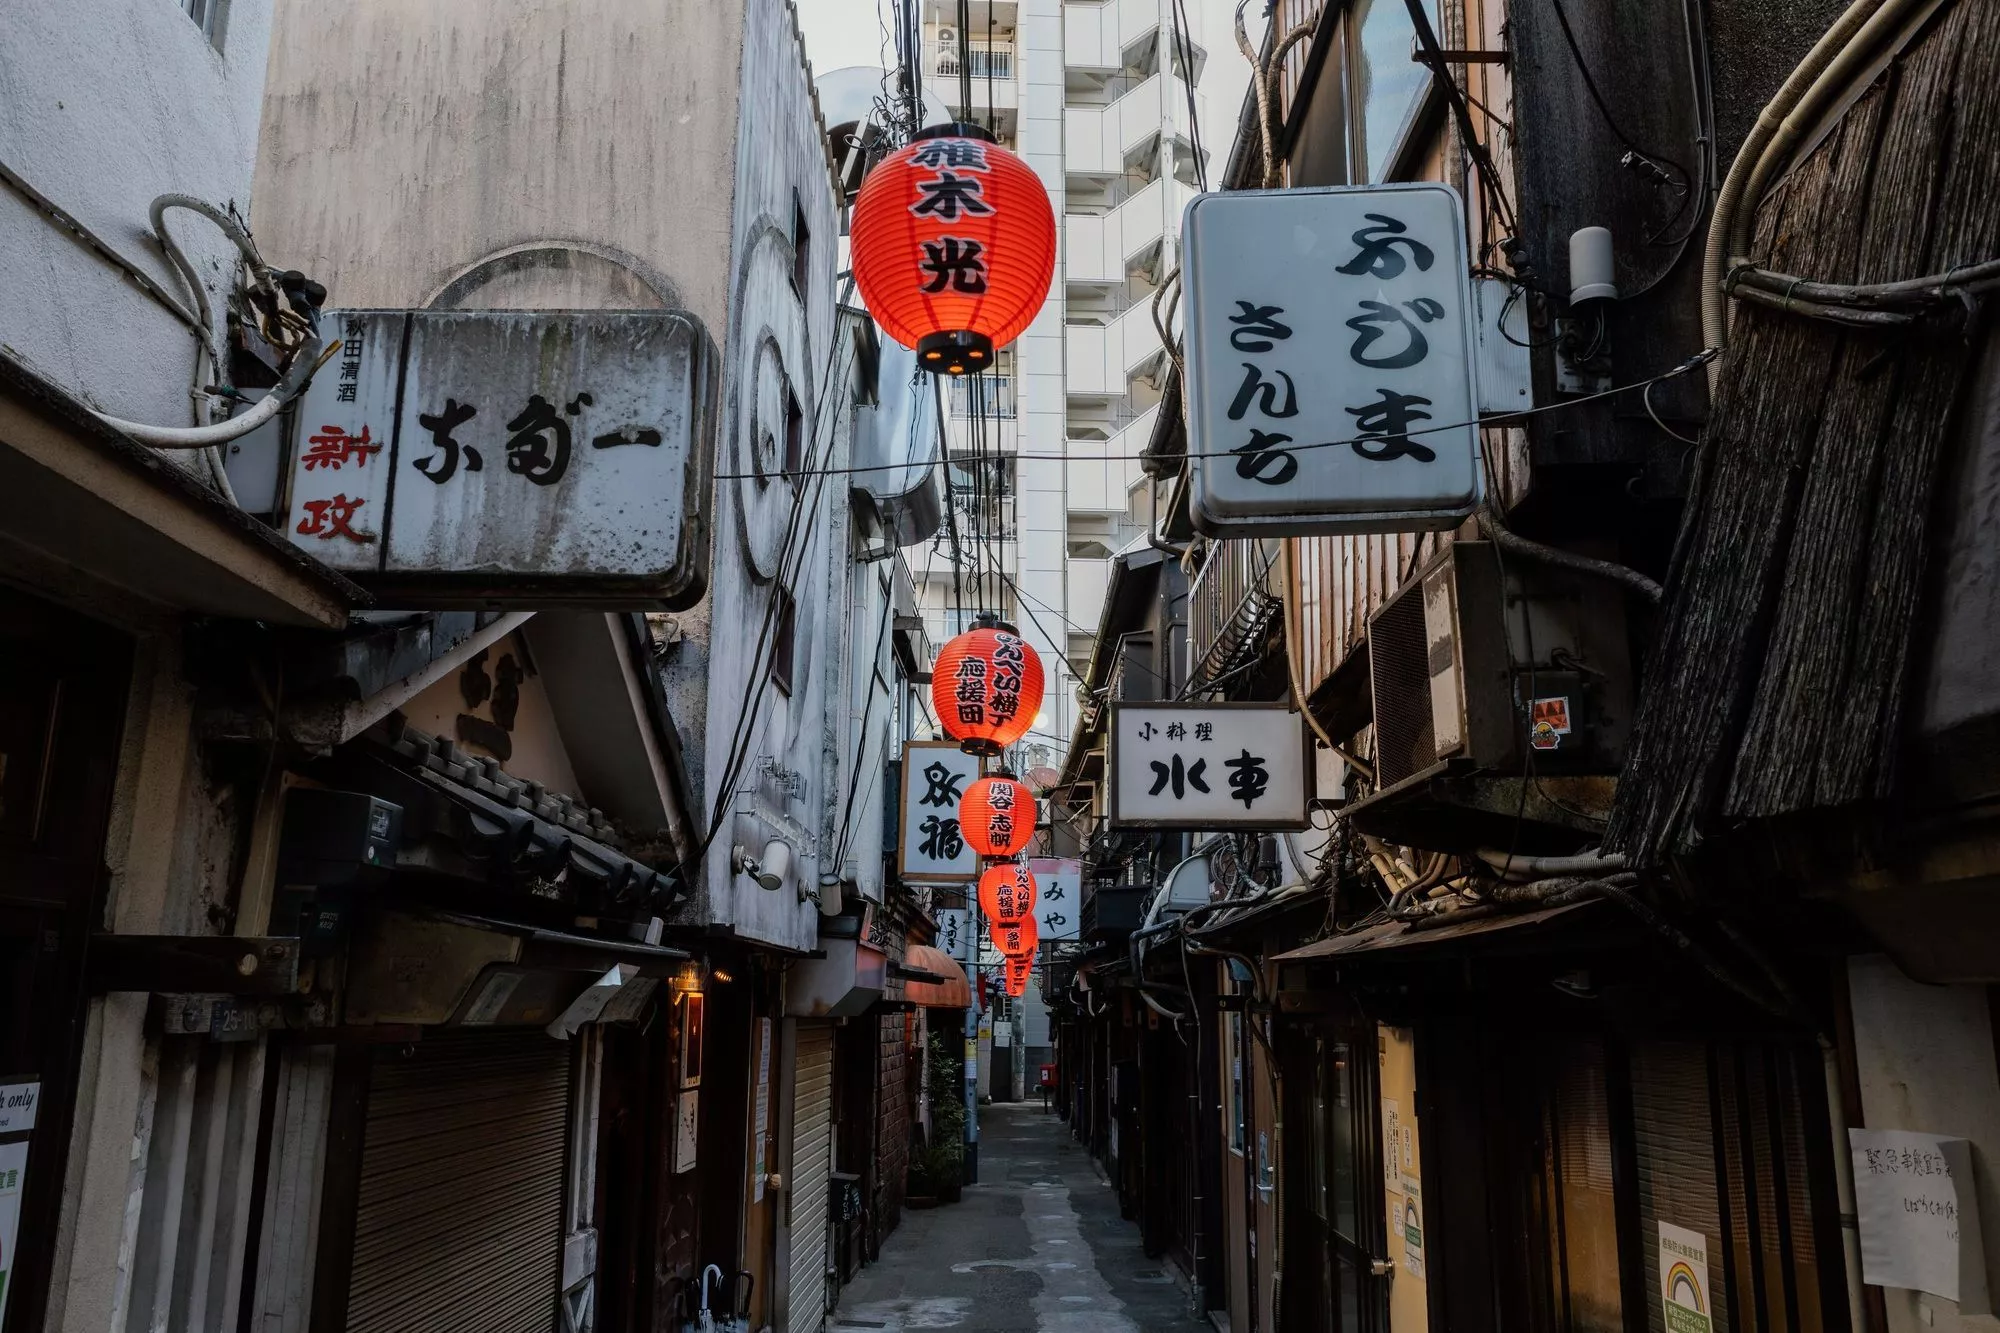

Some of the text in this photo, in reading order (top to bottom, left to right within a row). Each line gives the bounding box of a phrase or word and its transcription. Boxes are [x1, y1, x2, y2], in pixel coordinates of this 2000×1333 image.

[336, 317, 366, 402] 秋田清酒
[296, 424, 383, 543] 新政
[956, 656, 986, 725] 応援団
[1138, 721, 1213, 742] 小料理
[1148, 748, 1269, 810] 水車
[1044, 881, 1066, 933] みや
[8, 1088, 34, 1112] only
